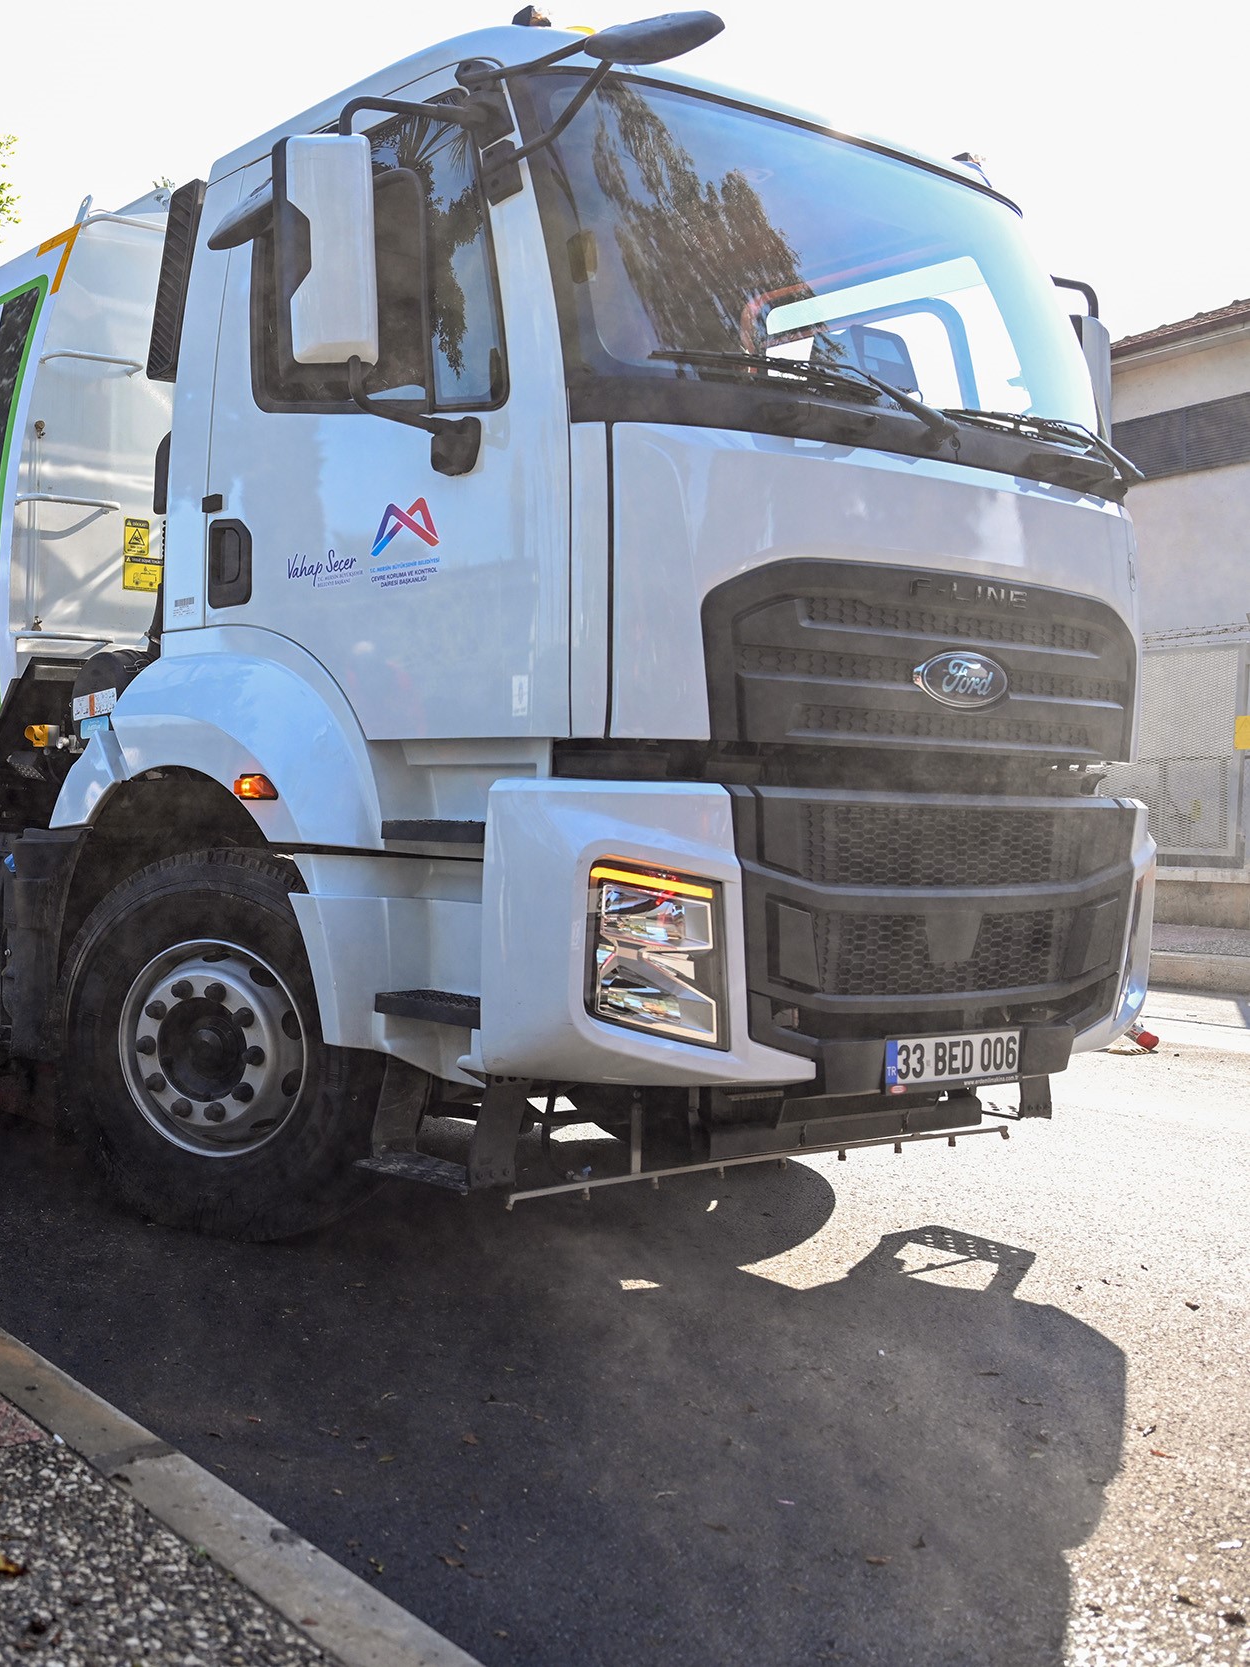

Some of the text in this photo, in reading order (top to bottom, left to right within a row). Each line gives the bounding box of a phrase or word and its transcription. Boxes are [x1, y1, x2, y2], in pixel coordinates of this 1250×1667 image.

[287, 549, 357, 587] Vahap Seçer
[415, 567, 438, 575] KONTROL
[909, 577, 1028, 609] F-LINE
[942, 659, 994, 696] Ford
[886, 1066, 897, 1076] TR
[897, 1035, 1017, 1079] 33 BED 006
